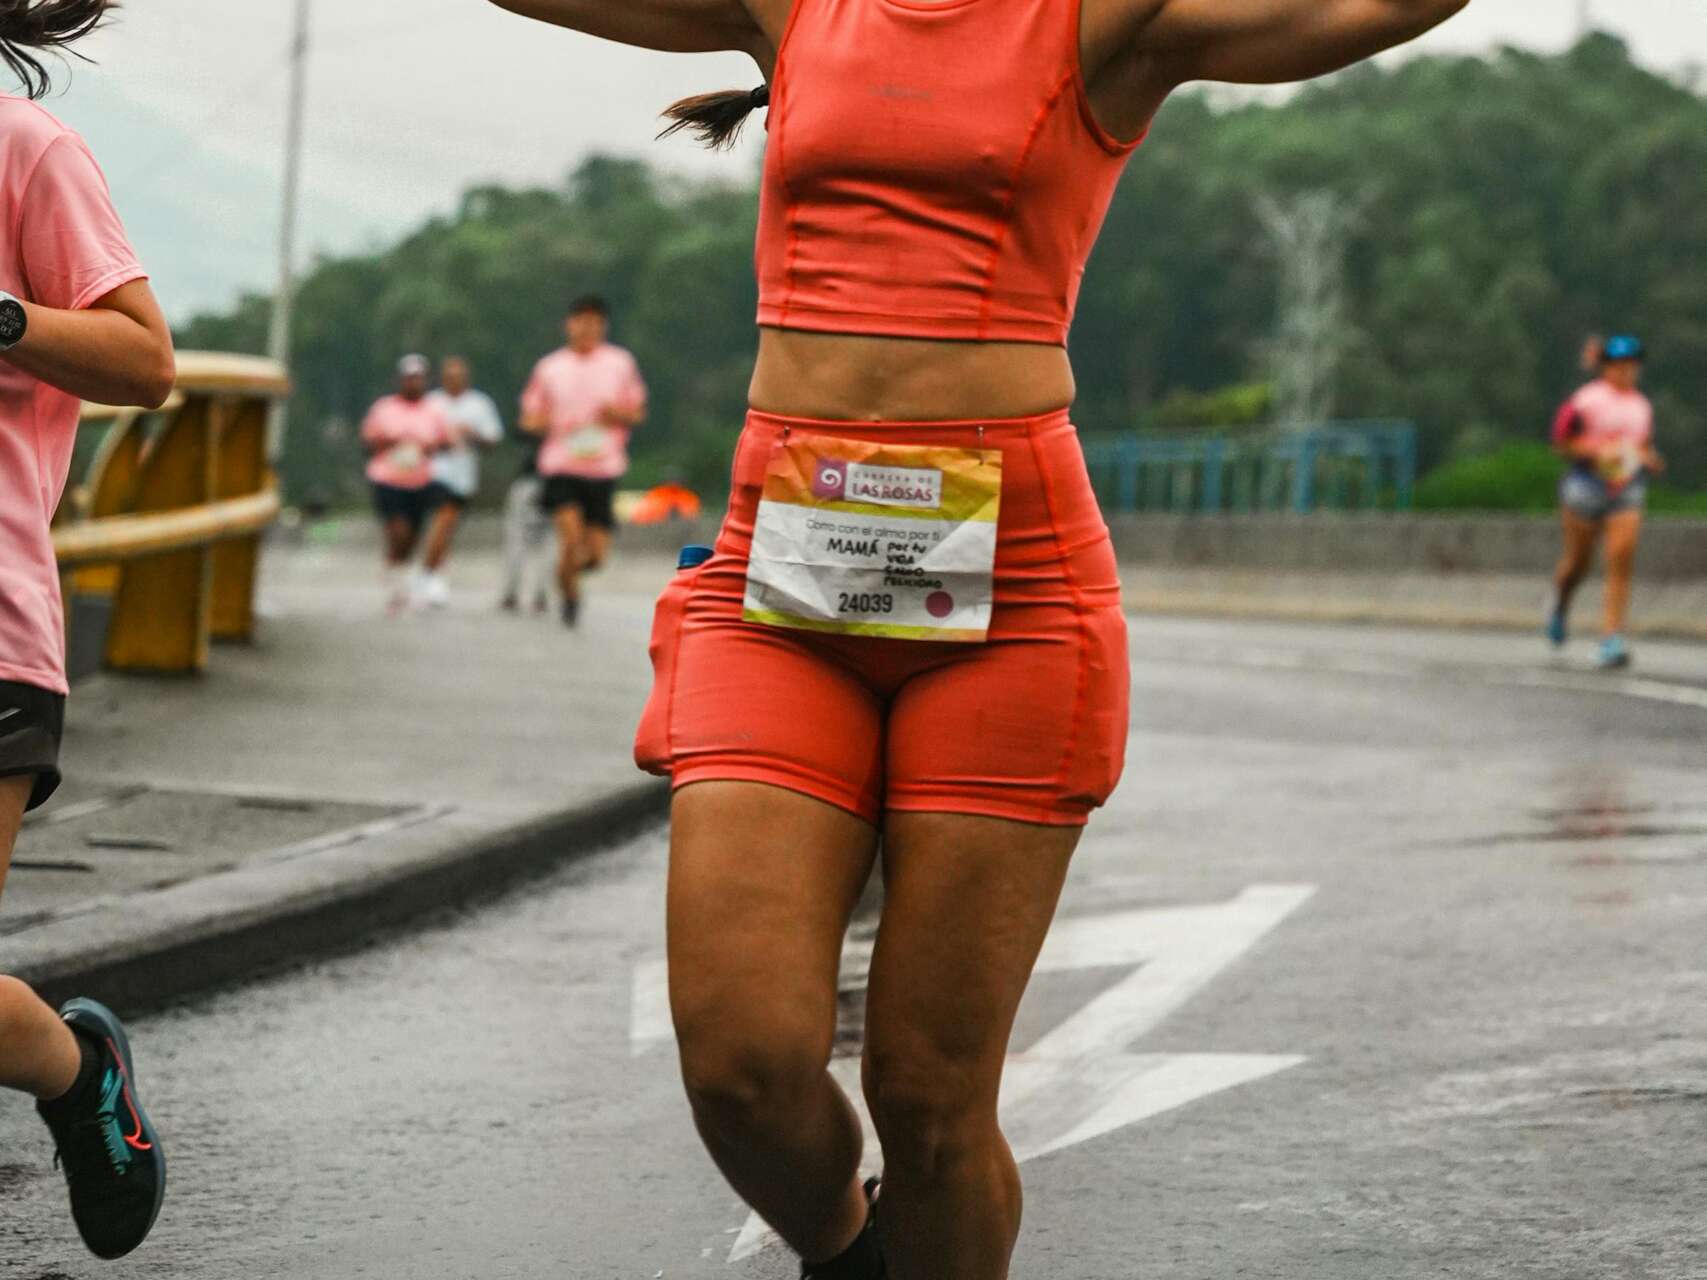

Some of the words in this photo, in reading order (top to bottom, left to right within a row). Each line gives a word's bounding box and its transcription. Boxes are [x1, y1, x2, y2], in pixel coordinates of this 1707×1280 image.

[838, 524, 858, 534] con
[862, 526, 871, 536] el
[875, 528, 907, 539] alma
[909, 531, 929, 542] por
[826, 537, 880, 558] MAMÁ
[838, 592, 893, 613] 24039
